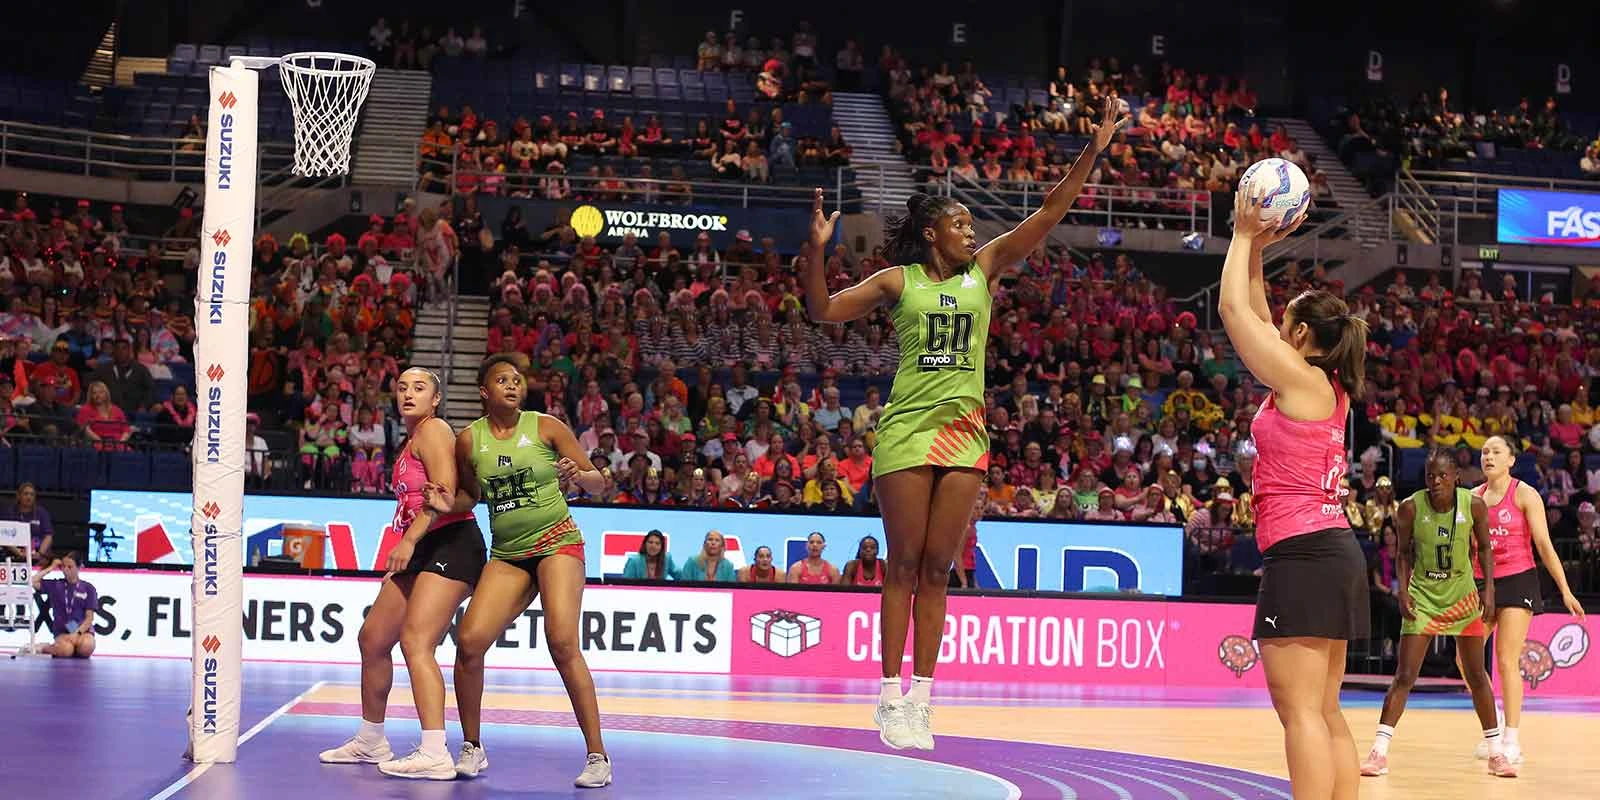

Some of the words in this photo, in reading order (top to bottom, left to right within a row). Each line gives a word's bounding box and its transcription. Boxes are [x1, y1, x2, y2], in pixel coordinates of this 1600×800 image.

[731, 10, 744, 30] F
[953, 23, 966, 42] E
[1152, 35, 1164, 55] E
[218, 114, 233, 190] SUZUKI
[604, 210, 727, 231] WOLFBROOK
[607, 226, 649, 238] ARENA
[1480, 248, 1499, 259] EXIT
[210, 251, 226, 325] SUZUKI
[926, 312, 974, 354] GD
[923, 354, 951, 366] myob
[207, 386, 222, 464] SUZUKI
[496, 501, 516, 512] myob
[204, 523, 218, 596] SUZUKI
[582, 611, 717, 654] REATS
[1096, 618, 1165, 669] BOX
[204, 657, 218, 734] SUZUKI
